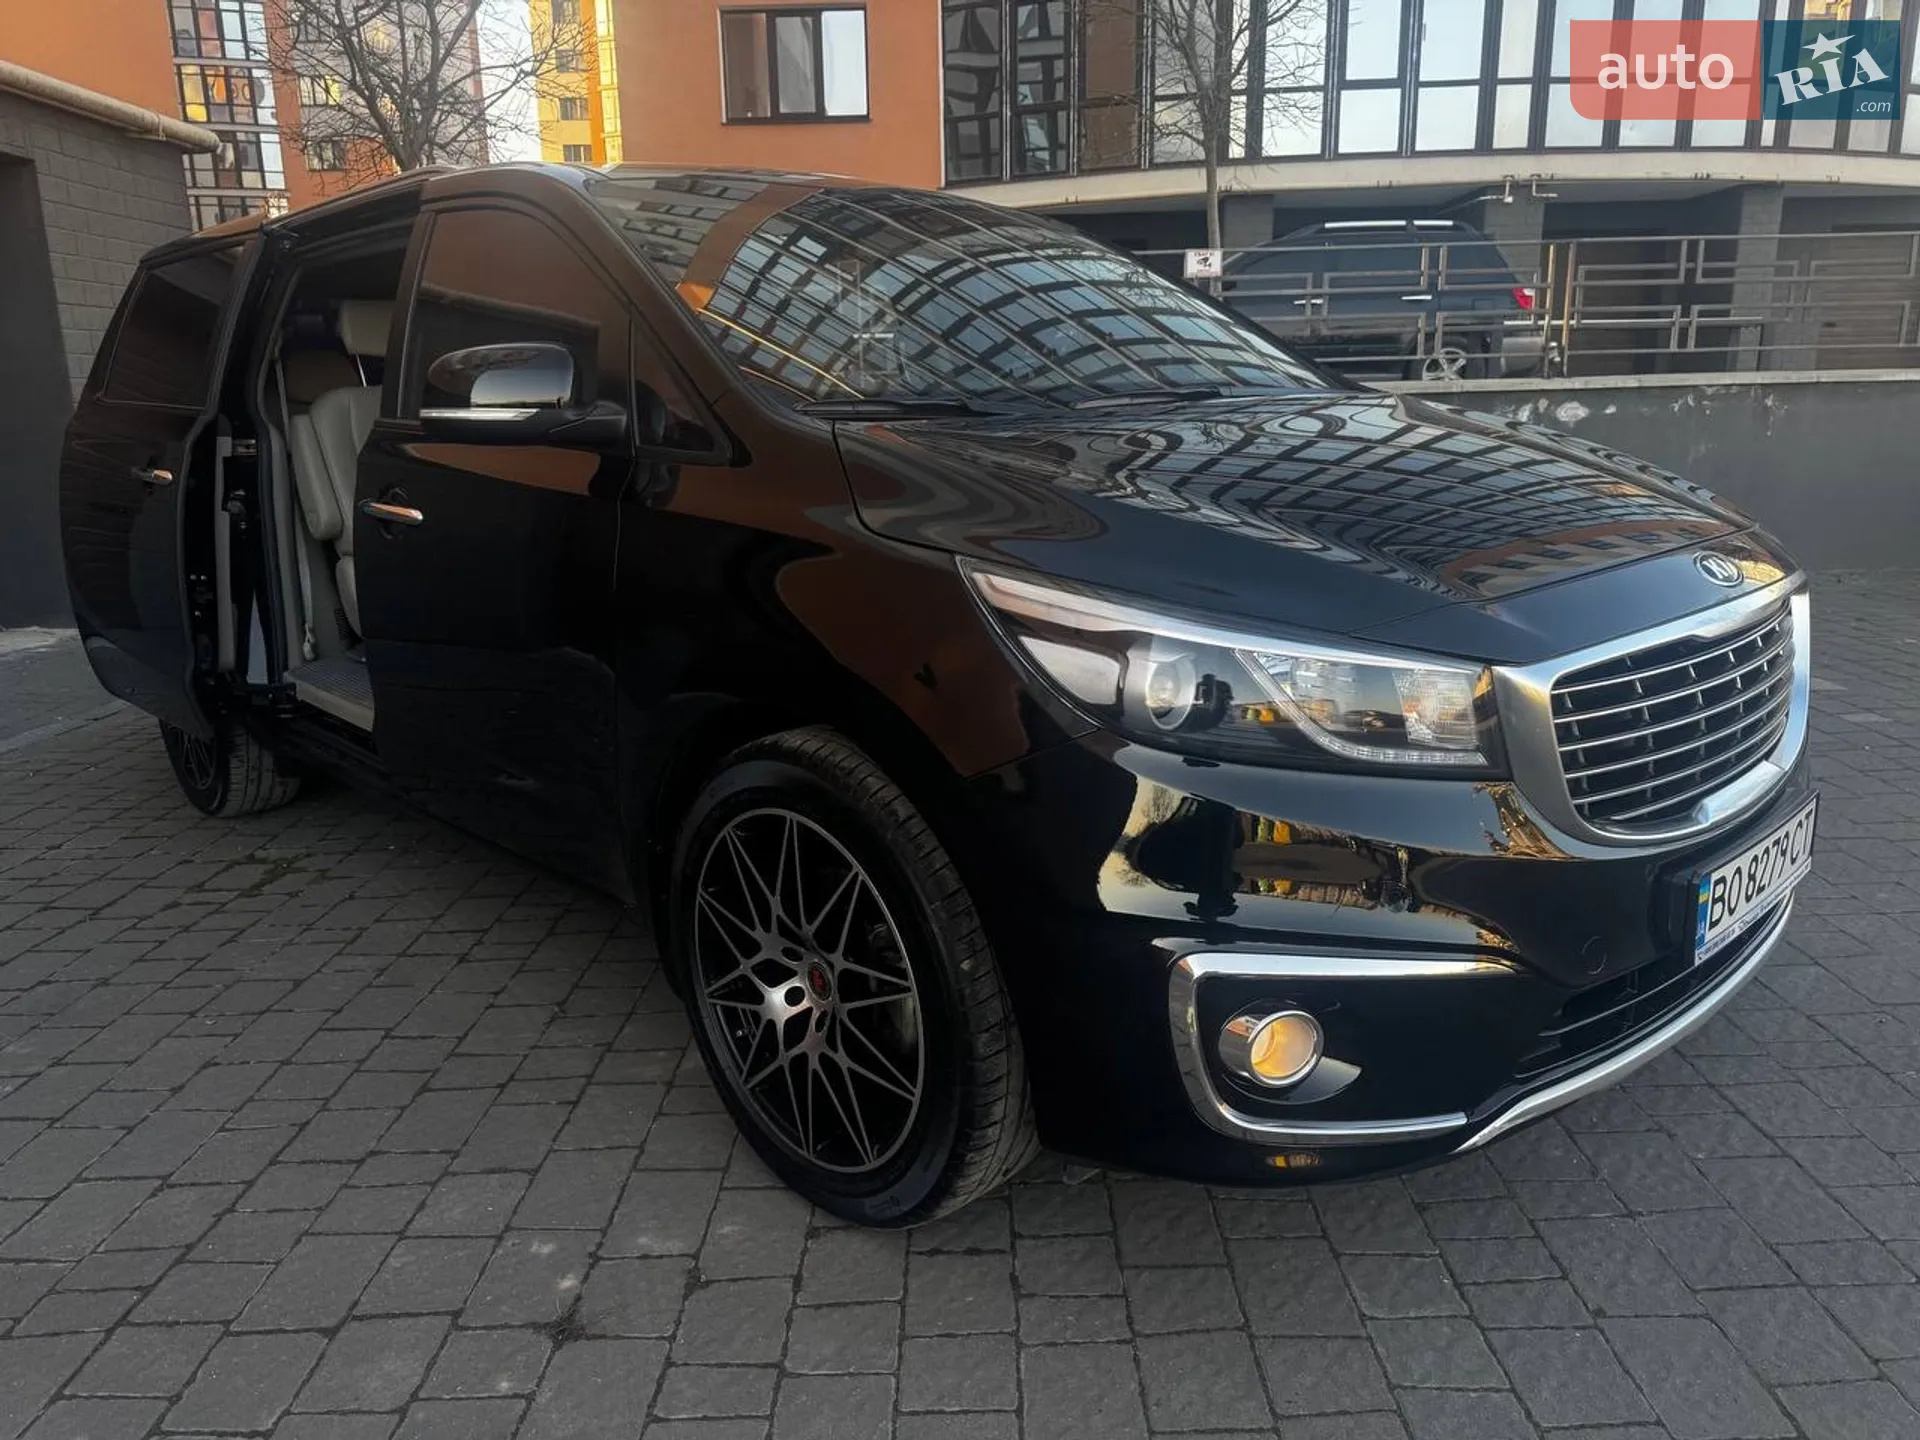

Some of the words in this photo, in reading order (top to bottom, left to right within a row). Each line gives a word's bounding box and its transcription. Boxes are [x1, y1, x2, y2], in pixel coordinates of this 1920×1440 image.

[1708, 866, 1743, 931] BO
[1744, 833, 1790, 904] 8279
[1790, 810, 1813, 865] CT
